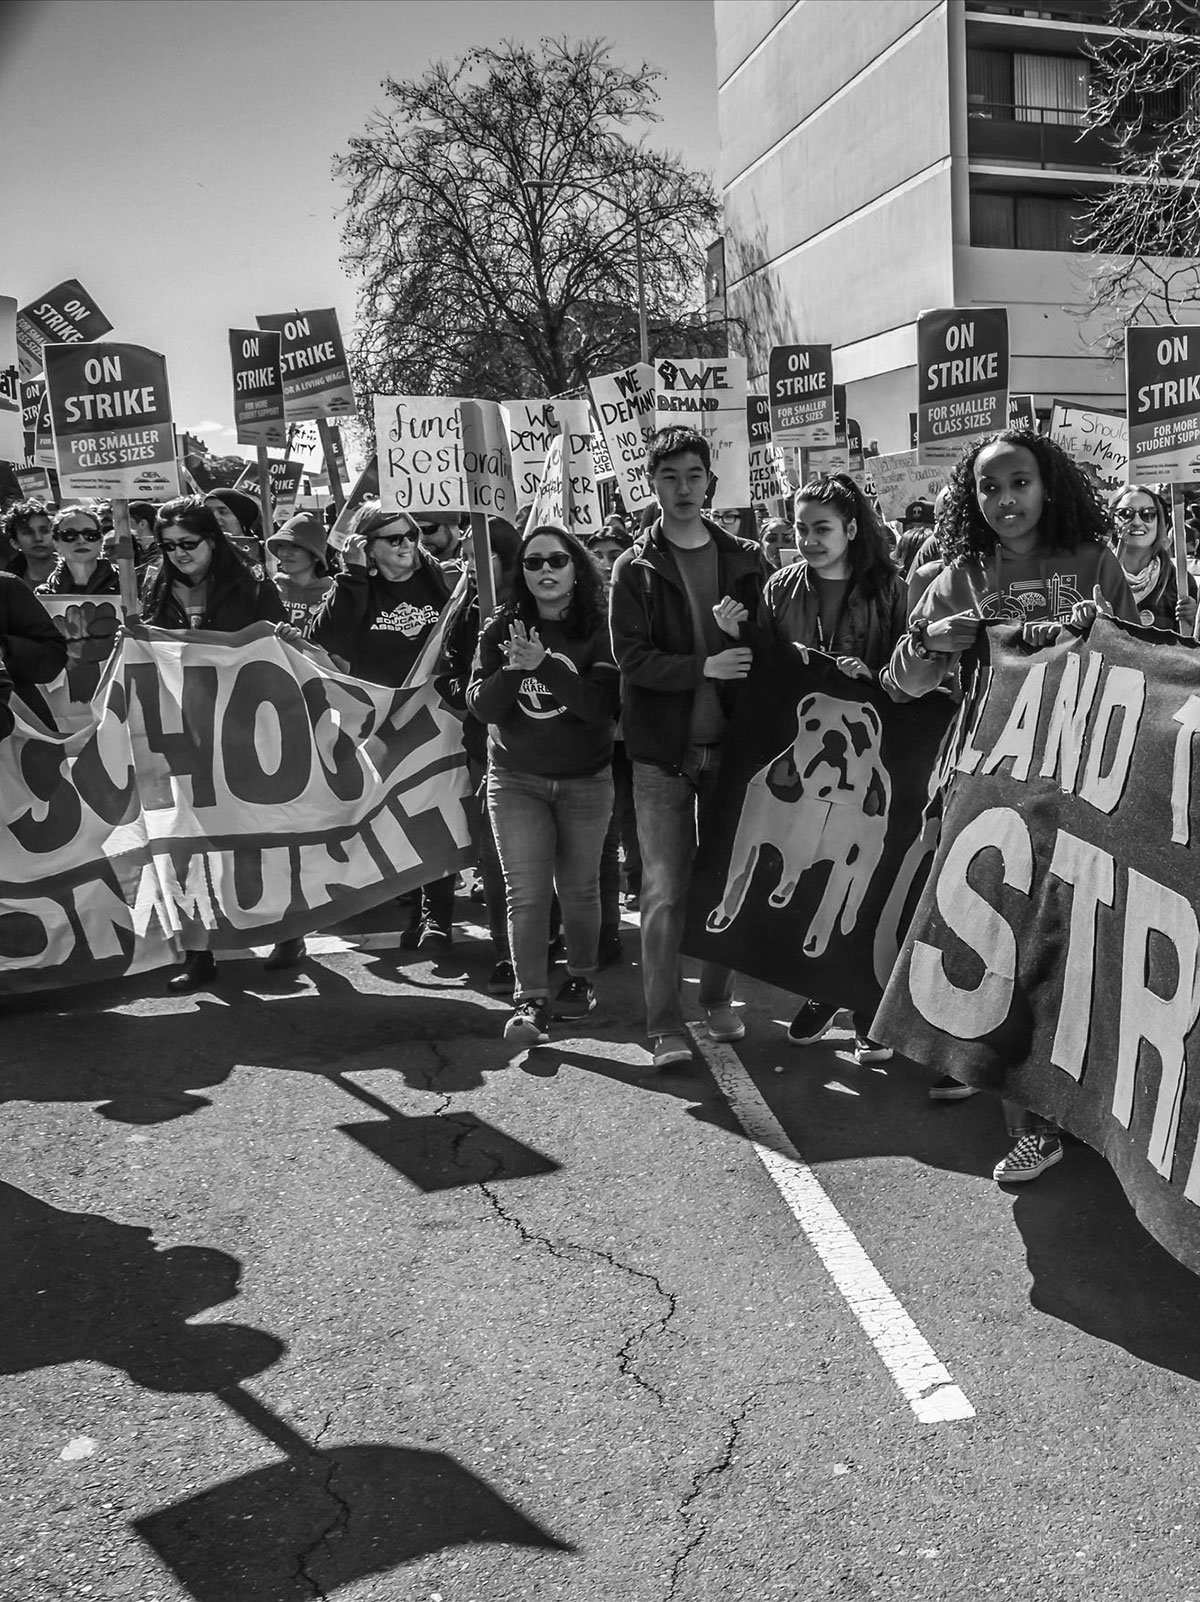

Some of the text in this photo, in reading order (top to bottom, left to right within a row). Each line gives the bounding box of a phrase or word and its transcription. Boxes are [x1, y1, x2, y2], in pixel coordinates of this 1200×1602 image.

[63, 300, 91, 321] ON
[284, 317, 311, 340] ON
[946, 322, 975, 352] ON
[242, 337, 259, 358] ON
[280, 341, 336, 374] STRIKE
[1157, 335, 1188, 366] ON
[84, 356, 122, 385] ON
[788, 352, 810, 372] ON
[927, 352, 998, 391] STRIKE
[236, 367, 275, 391] STRIKE
[325, 370, 346, 383] WAGE
[613, 369, 641, 398] WE
[679, 366, 728, 390] WE
[776, 372, 827, 397] STRIKE
[26, 384, 40, 399] ON
[657, 395, 719, 411] DEMAND
[64, 386, 157, 423] STRIKE
[777, 400, 827, 418] FOR SMALLER
[928, 396, 996, 422] FOR SMALLER
[781, 414, 804, 427] CLASS
[805, 410, 824, 423] SIZES
[932, 412, 991, 435] CLASS SIZES
[1059, 408, 1072, 428] I
[1153, 418, 1198, 438] FOR MORE
[70, 430, 160, 454] FOR SMALLER
[616, 431, 637, 449] NO
[1136, 435, 1176, 454] STUDENT
[78, 445, 155, 467] CLASS SIZES
[370, 617, 439, 632] ASSOCIATIO
[0, 766, 473, 970] OMMUNIT
